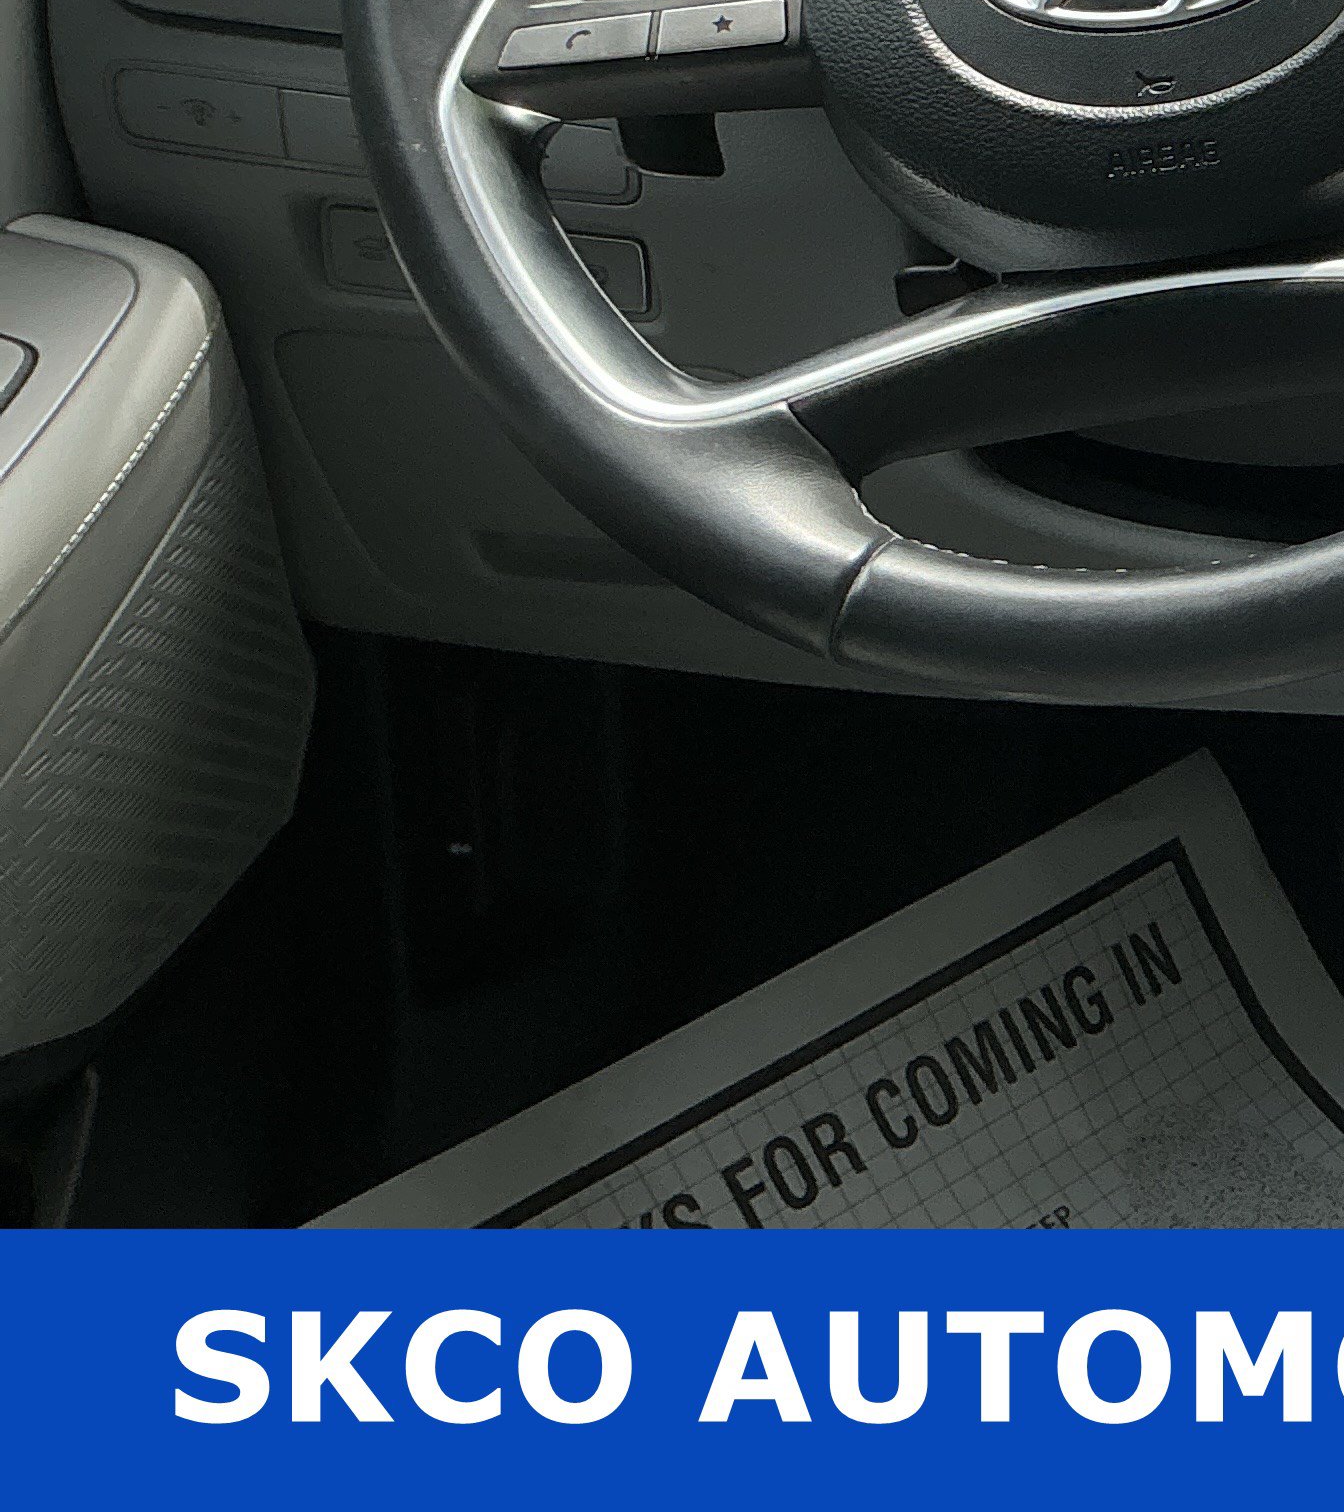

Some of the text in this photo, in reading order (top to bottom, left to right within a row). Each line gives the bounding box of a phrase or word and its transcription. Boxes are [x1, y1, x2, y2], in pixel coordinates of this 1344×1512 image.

[720, 1111, 867, 1230] FOR
[864, 964, 1115, 1149] COMING
[1111, 920, 1184, 1006] IN
